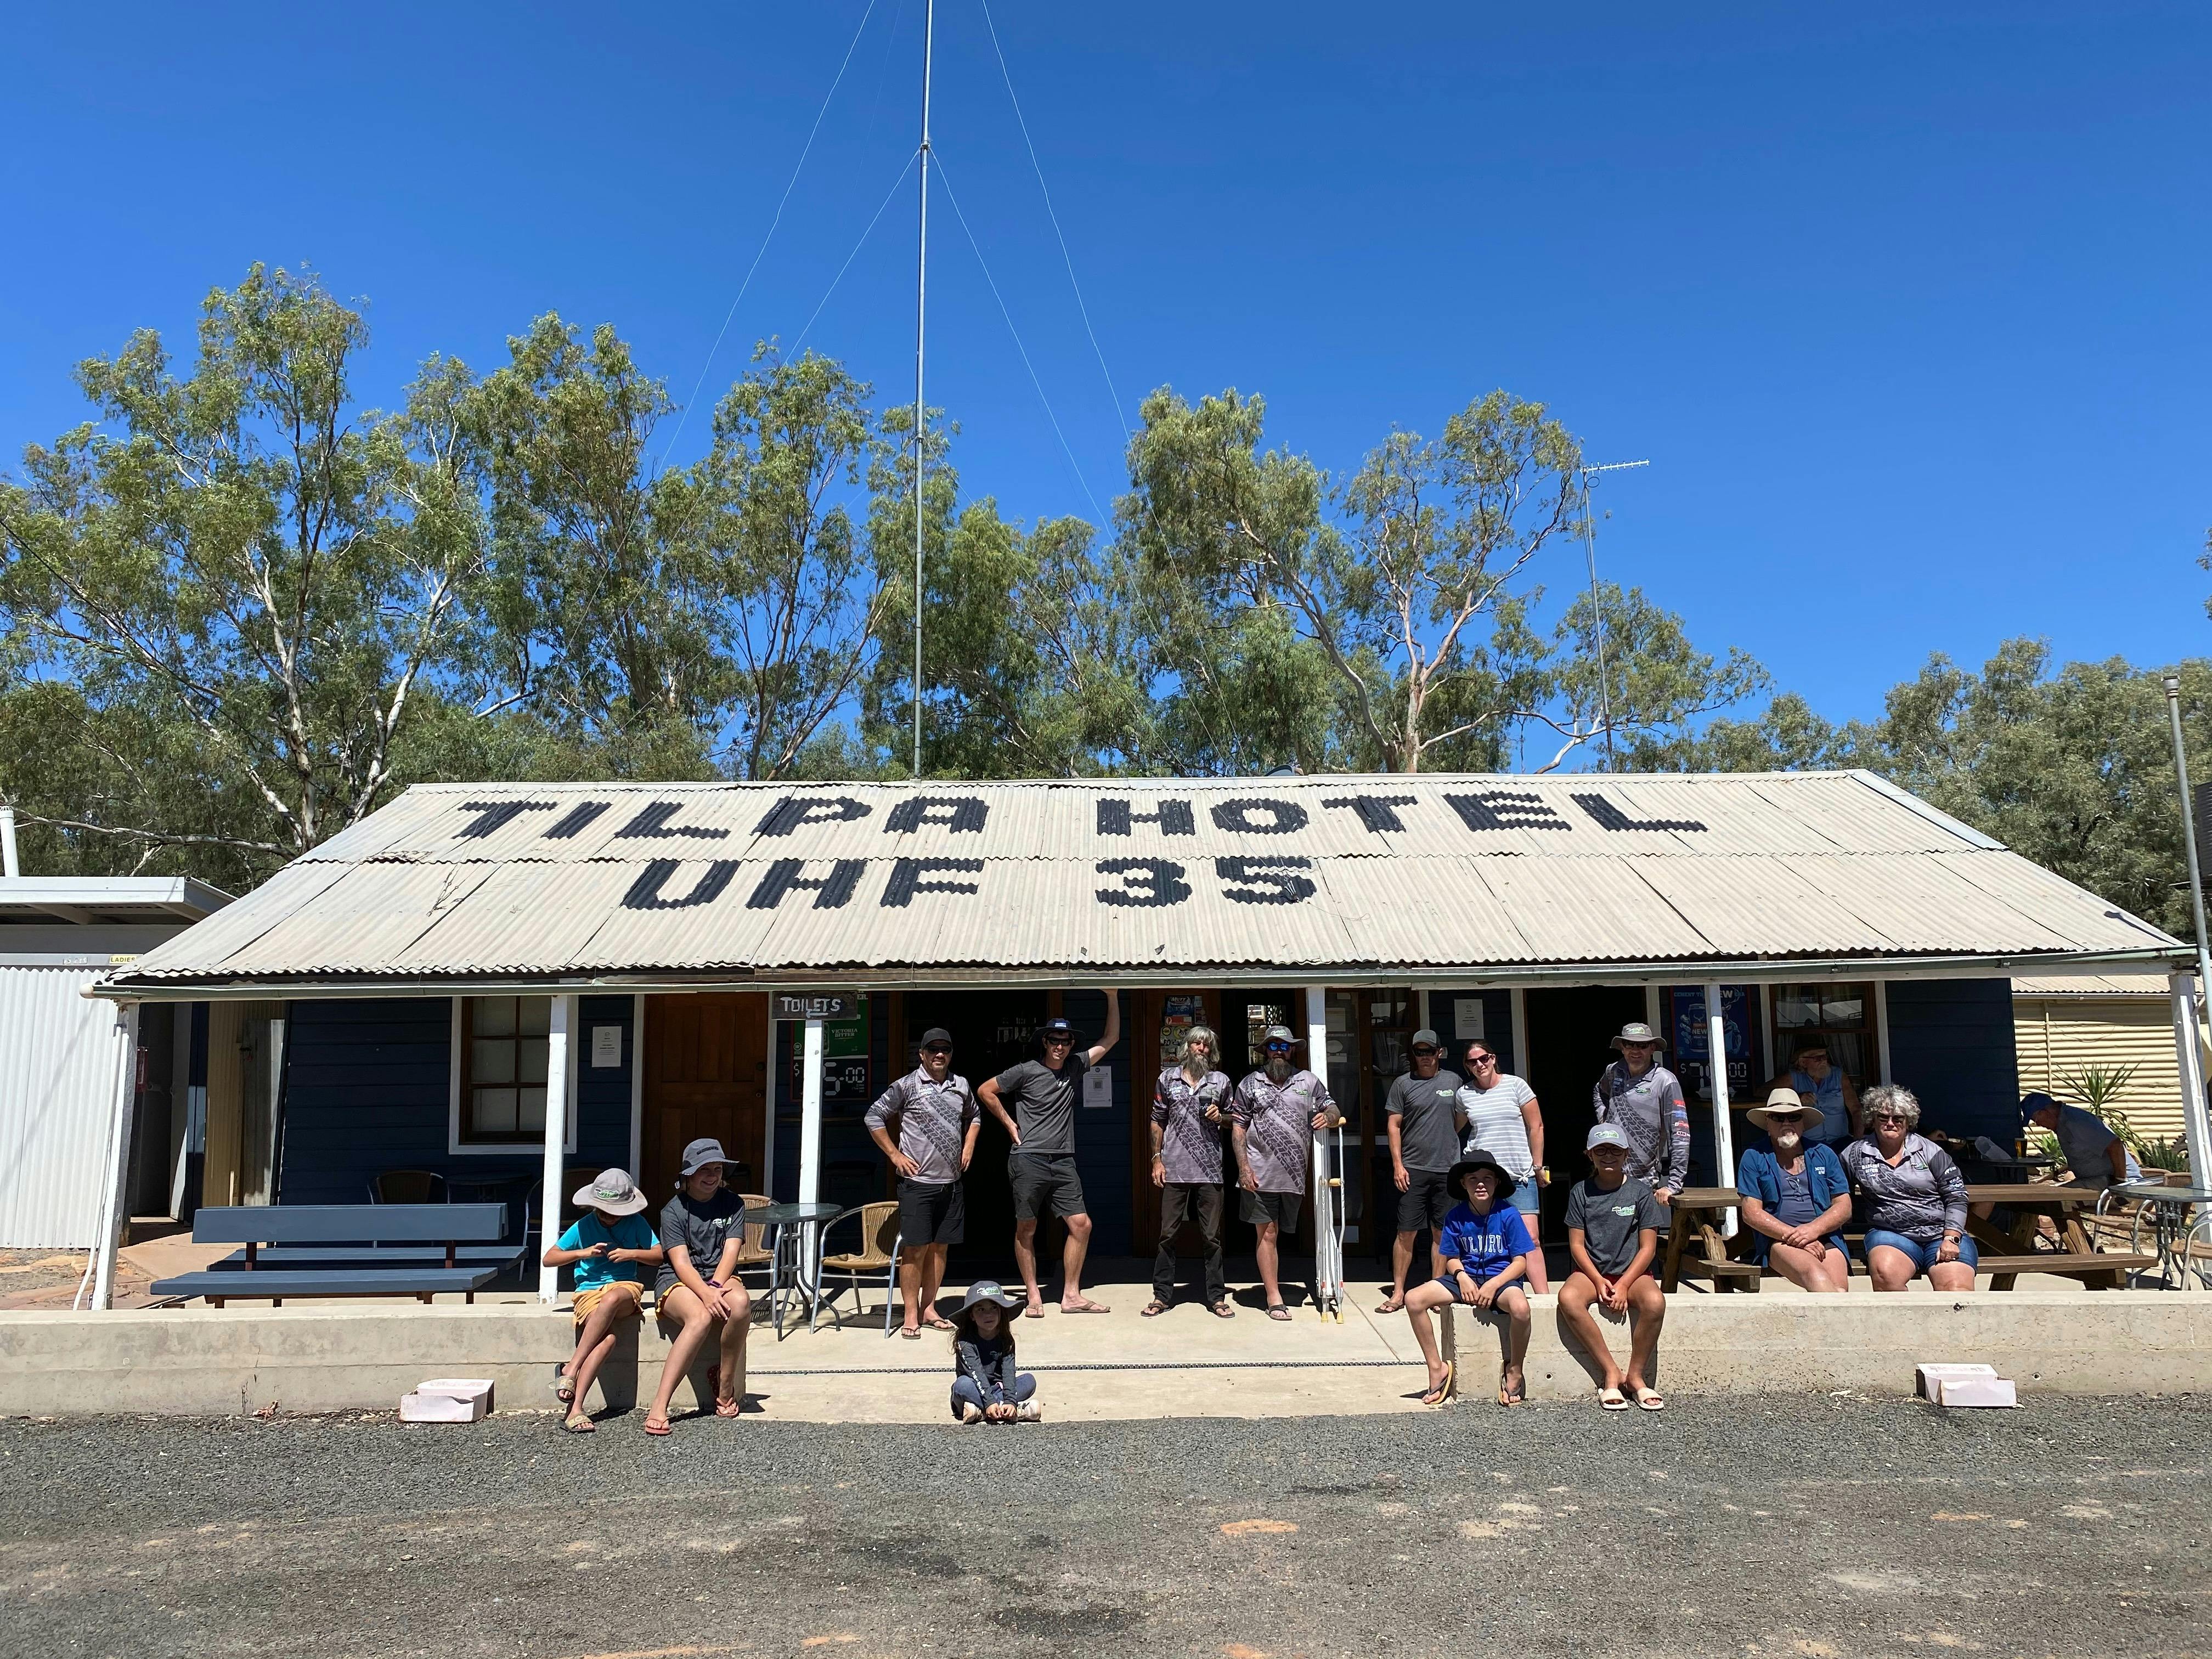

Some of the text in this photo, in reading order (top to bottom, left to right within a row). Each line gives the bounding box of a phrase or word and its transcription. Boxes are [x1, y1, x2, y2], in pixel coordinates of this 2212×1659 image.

[452, 790, 1709, 840] TILPA HOTEL
[619, 856, 1318, 910] UHF 35
[1719, 990, 1733, 998] EW
[780, 996, 842, 1012] TOILETS
[793, 1062, 800, 1077] $
[1680, 1063, 1686, 1074] $
